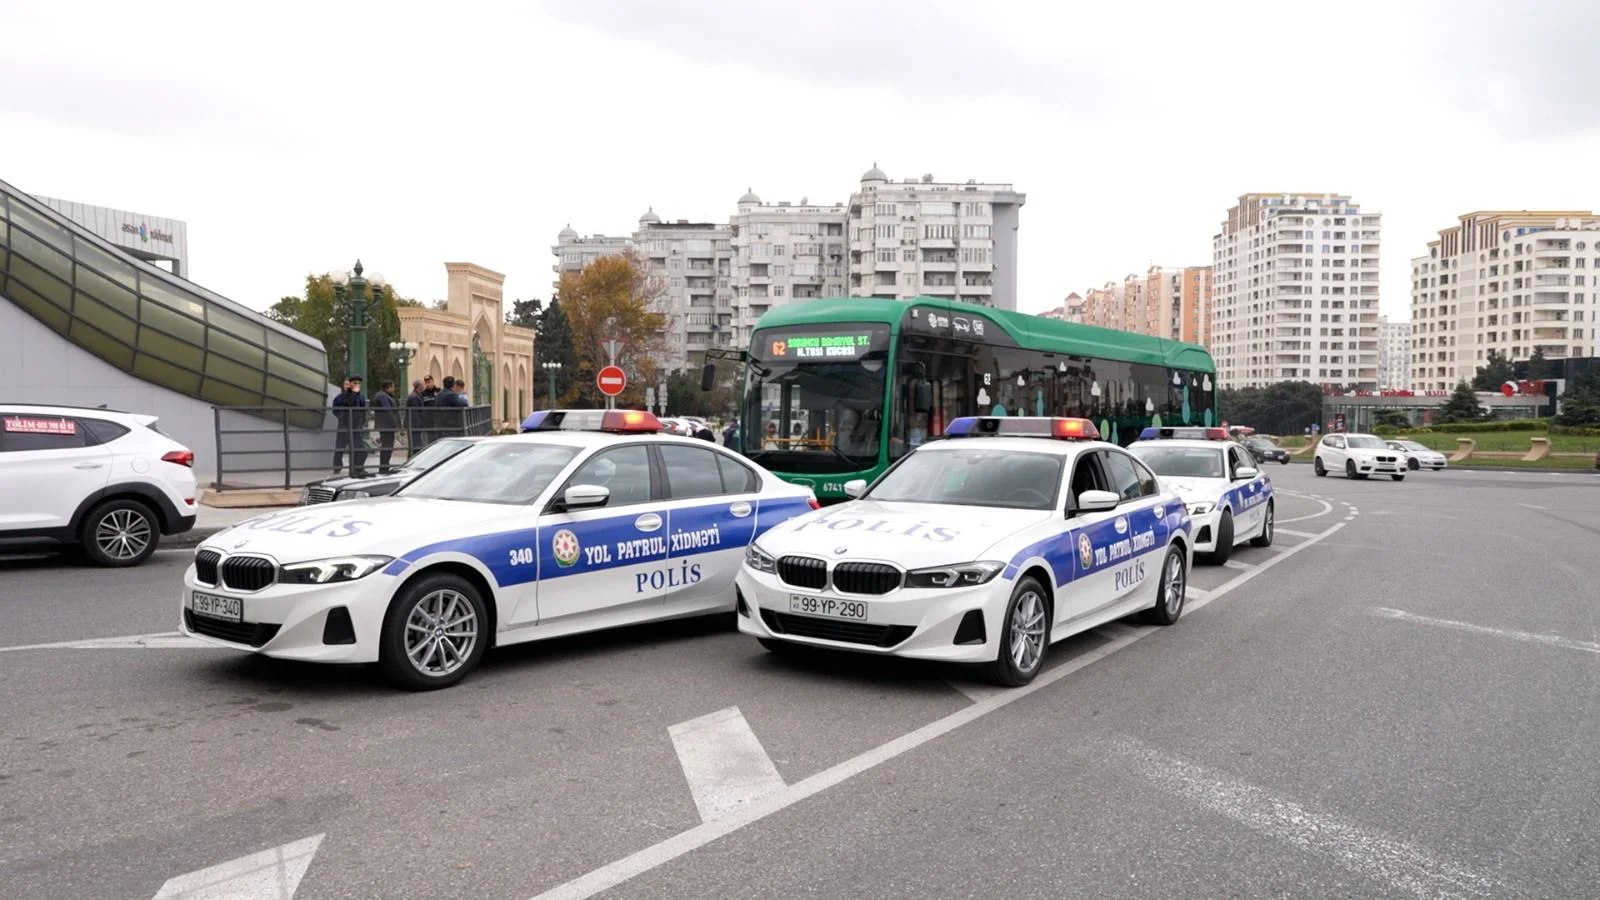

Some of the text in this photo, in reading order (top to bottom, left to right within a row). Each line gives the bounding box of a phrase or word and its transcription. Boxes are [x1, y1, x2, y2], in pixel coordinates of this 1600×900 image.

[772, 341, 786, 356] 62
[857, 335, 870, 346] ST.
[823, 483, 843, 492] 6741
[584, 523, 720, 566] YOL PATRUL XİDMƏTİ
[1094, 546, 1108, 567] YOL
[1109, 538, 1132, 561] PATRUL
[510, 547, 533, 566] 340
[635, 559, 701, 593] POLİS
[1115, 558, 1145, 591] POLİS
[200, 594, 240, 616] 99-YP-340
[802, 597, 865, 618] 99-YP-290
